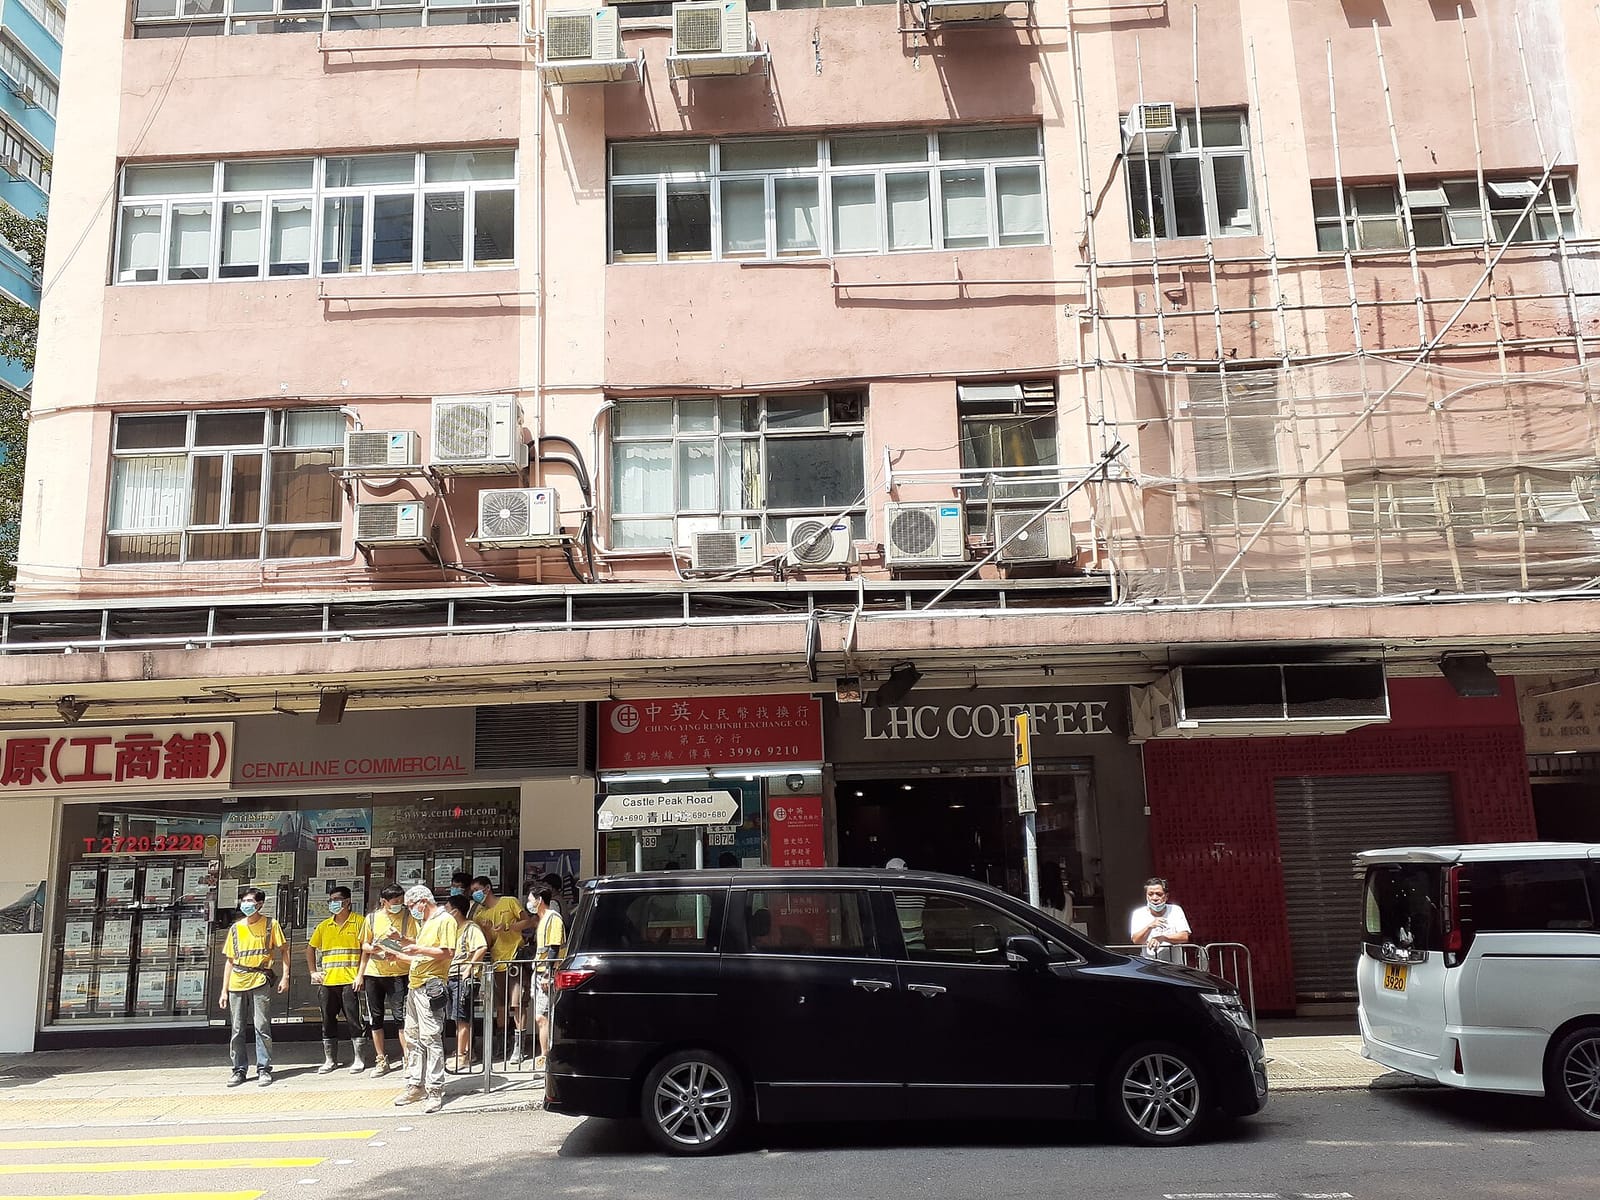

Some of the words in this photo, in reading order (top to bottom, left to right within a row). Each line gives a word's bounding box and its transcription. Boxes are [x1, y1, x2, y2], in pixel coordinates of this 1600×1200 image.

[645, 725, 677, 733] CHUNG
[679, 724, 701, 732] YING
[703, 722, 741, 730] REMINBI
[744, 720, 792, 729] EXCHANGE
[794, 719, 811, 727] CO.
[863, 705, 940, 740] LHC
[947, 701, 1113, 739] COFFEE
[680, 733, 742, 745] 第五分行
[729, 747, 761, 758] 3996
[767, 745, 799, 756] 9210
[0, 731, 227, 787] 原(工商舖)
[242, 760, 340, 779] CENTALINE
[344, 755, 467, 775] COMMERCIAL
[622, 797, 655, 807] Castle
[657, 795, 683, 806] Peak
[686, 795, 713, 804] Road
[691, 811, 727, 819] 690-680
[83, 837, 97, 853] T
[155, 833, 205, 852] 3228
[1385, 976, 1404, 990] 3920
